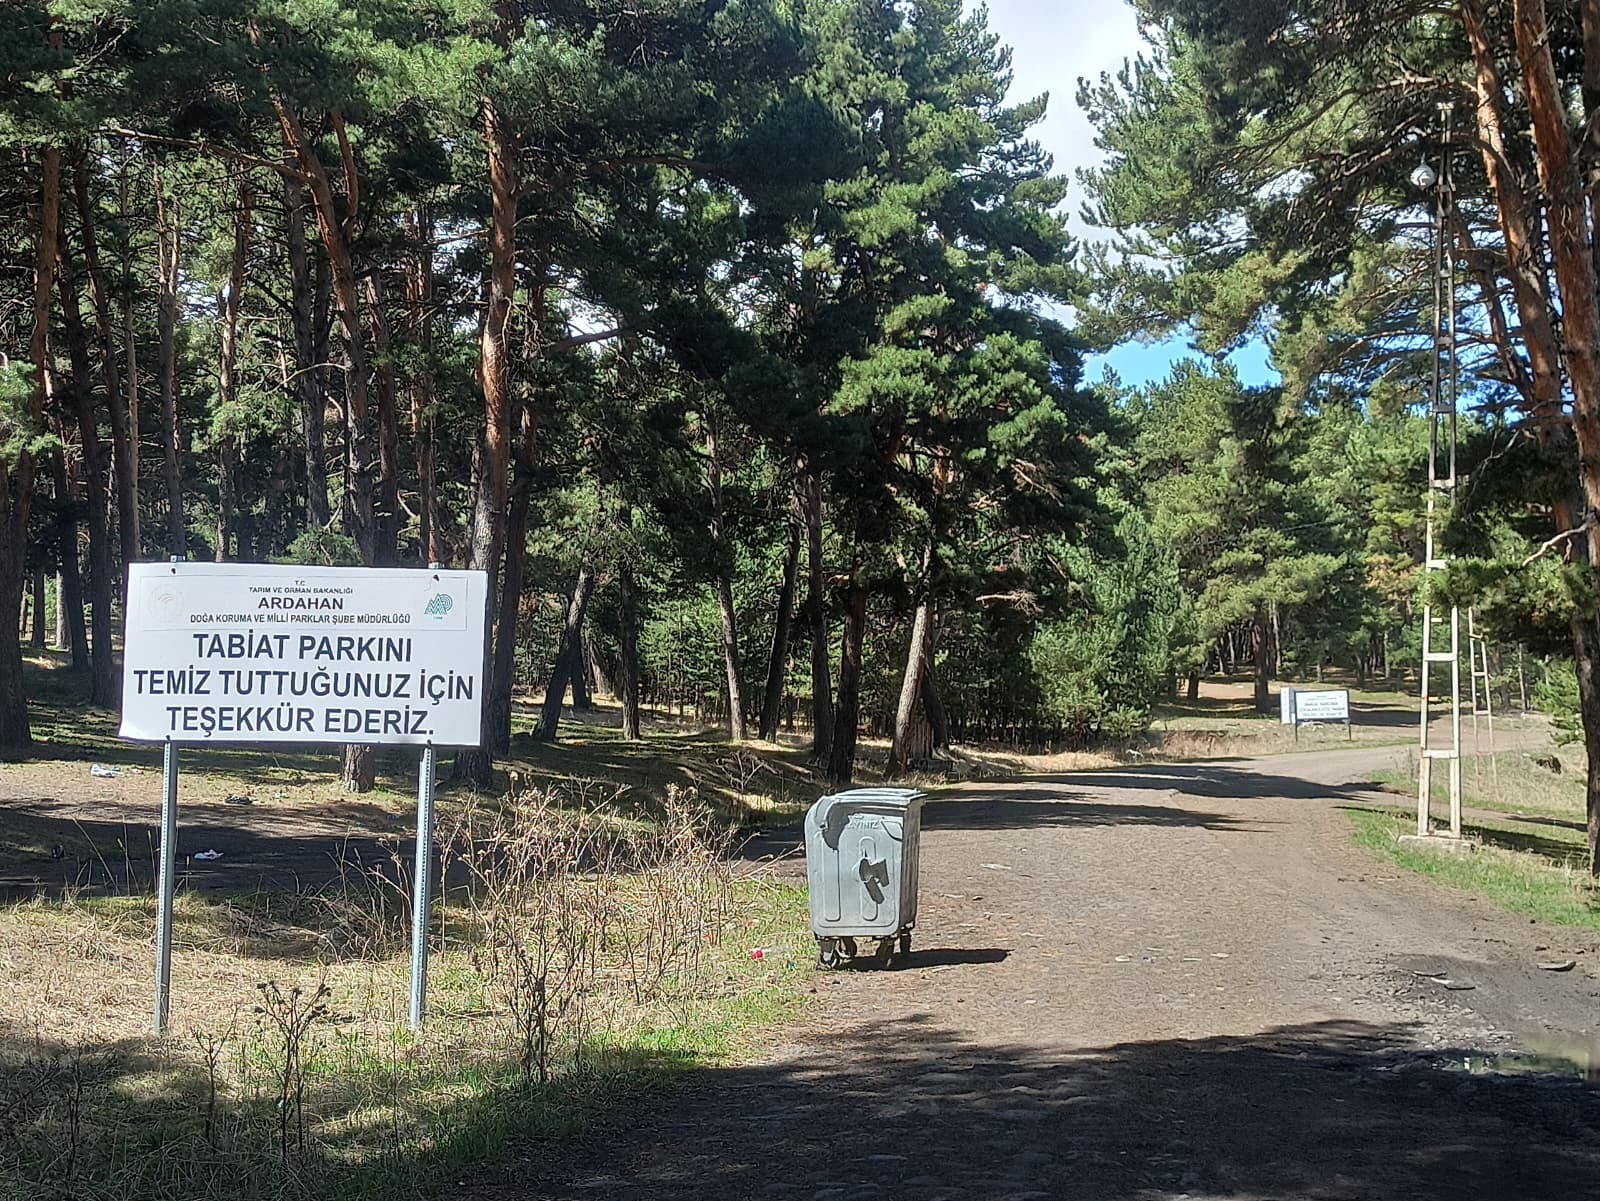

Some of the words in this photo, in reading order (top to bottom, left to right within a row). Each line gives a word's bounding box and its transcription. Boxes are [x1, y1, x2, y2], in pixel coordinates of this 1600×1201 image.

[273, 586, 282, 594] VE
[284, 586, 311, 594] ORMAN
[257, 596, 344, 610] ARDAHAN
[190, 613, 214, 623] DOĞA
[215, 614, 252, 623] KORUMA
[254, 614, 265, 623] VE
[267, 612, 289, 623] MİLLİ
[290, 614, 331, 624] PARKLAR
[333, 614, 355, 625] ŞUBE
[357, 613, 411, 624] MÜDÜRLÜĞÜ
[192, 628, 291, 660] TABİAT
[298, 635, 412, 663] PARKINI
[133, 664, 211, 695] TEMİZ
[218, 665, 411, 699] TUTTUĞUNUZ
[419, 668, 474, 706] İÇİN
[166, 701, 315, 738] TEŞEKKÜR
[324, 704, 434, 735] EDERİZ.
